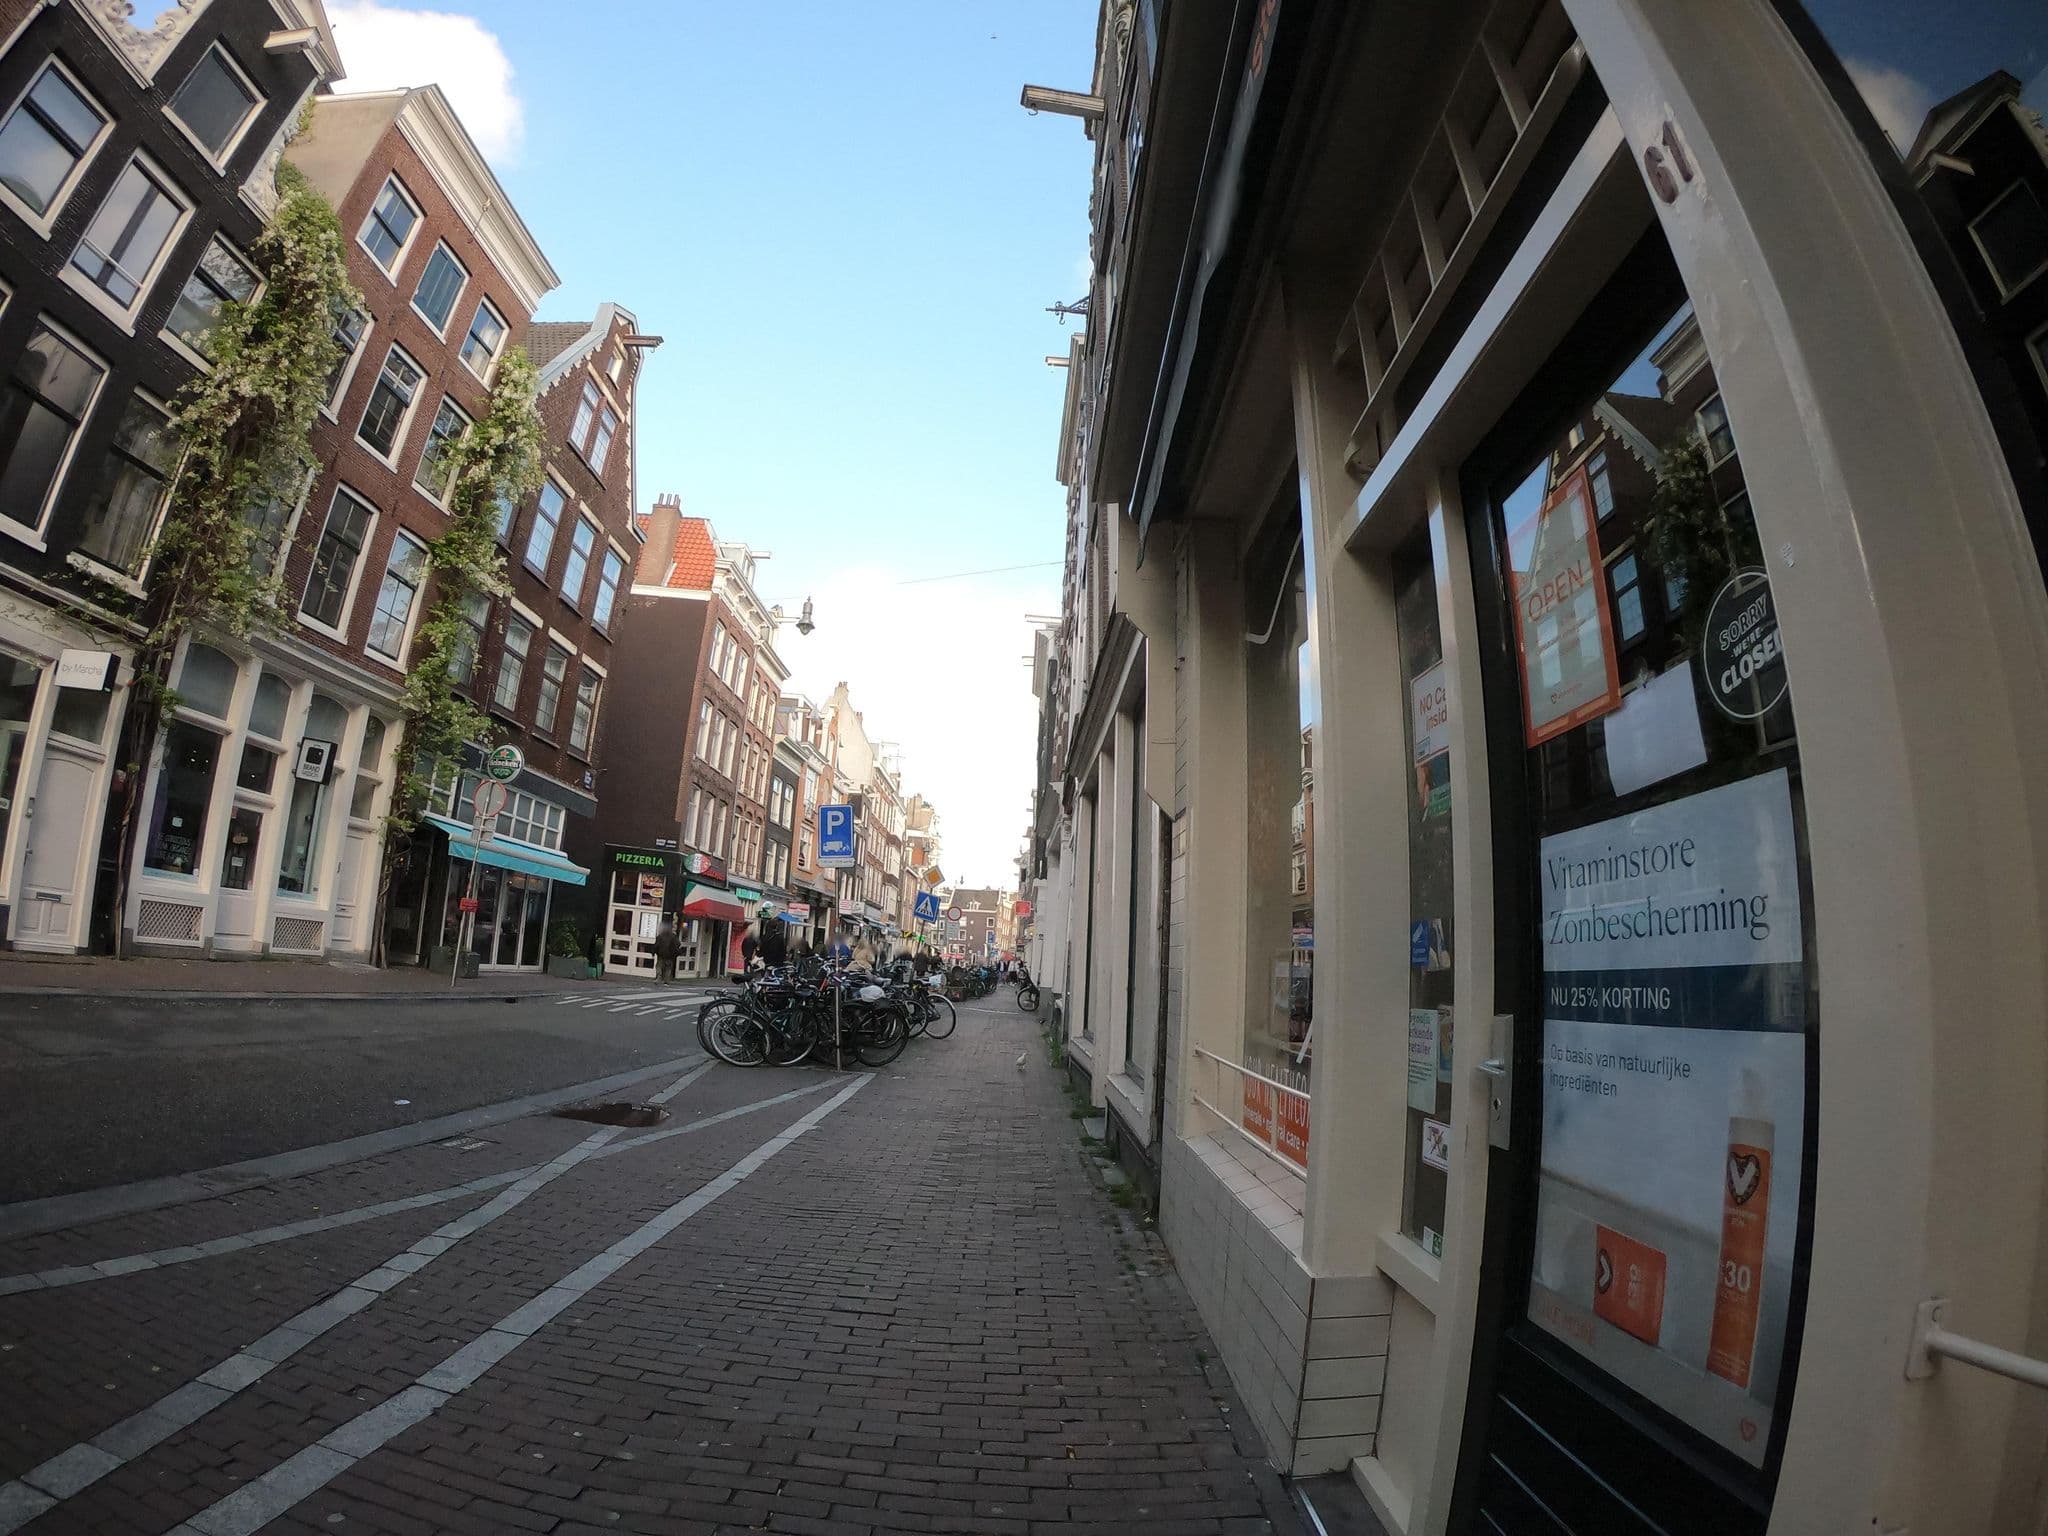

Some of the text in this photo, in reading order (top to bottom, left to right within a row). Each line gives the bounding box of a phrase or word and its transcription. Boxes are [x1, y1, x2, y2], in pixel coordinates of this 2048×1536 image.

[1643, 120, 1694, 204] 61
[1528, 560, 1585, 623] OPEN
[1719, 592, 1767, 651] SORRY
[1732, 626, 1762, 658] WE'RE
[1420, 693, 1432, 715] NO
[1427, 704, 1448, 730] insid
[827, 810, 845, 836] P
[615, 853, 665, 867] PIZZERIA
[1548, 838, 1696, 890] Vitaminstore
[1549, 888, 1770, 944] Zonbescherming
[1551, 987, 1671, 1010] NU 25% KORTING
[1551, 1043, 1691, 1081] Op basis van natuurlijke
[1551, 1069, 1617, 1097] ingrediënten
[1724, 1260, 1751, 1293] 30
